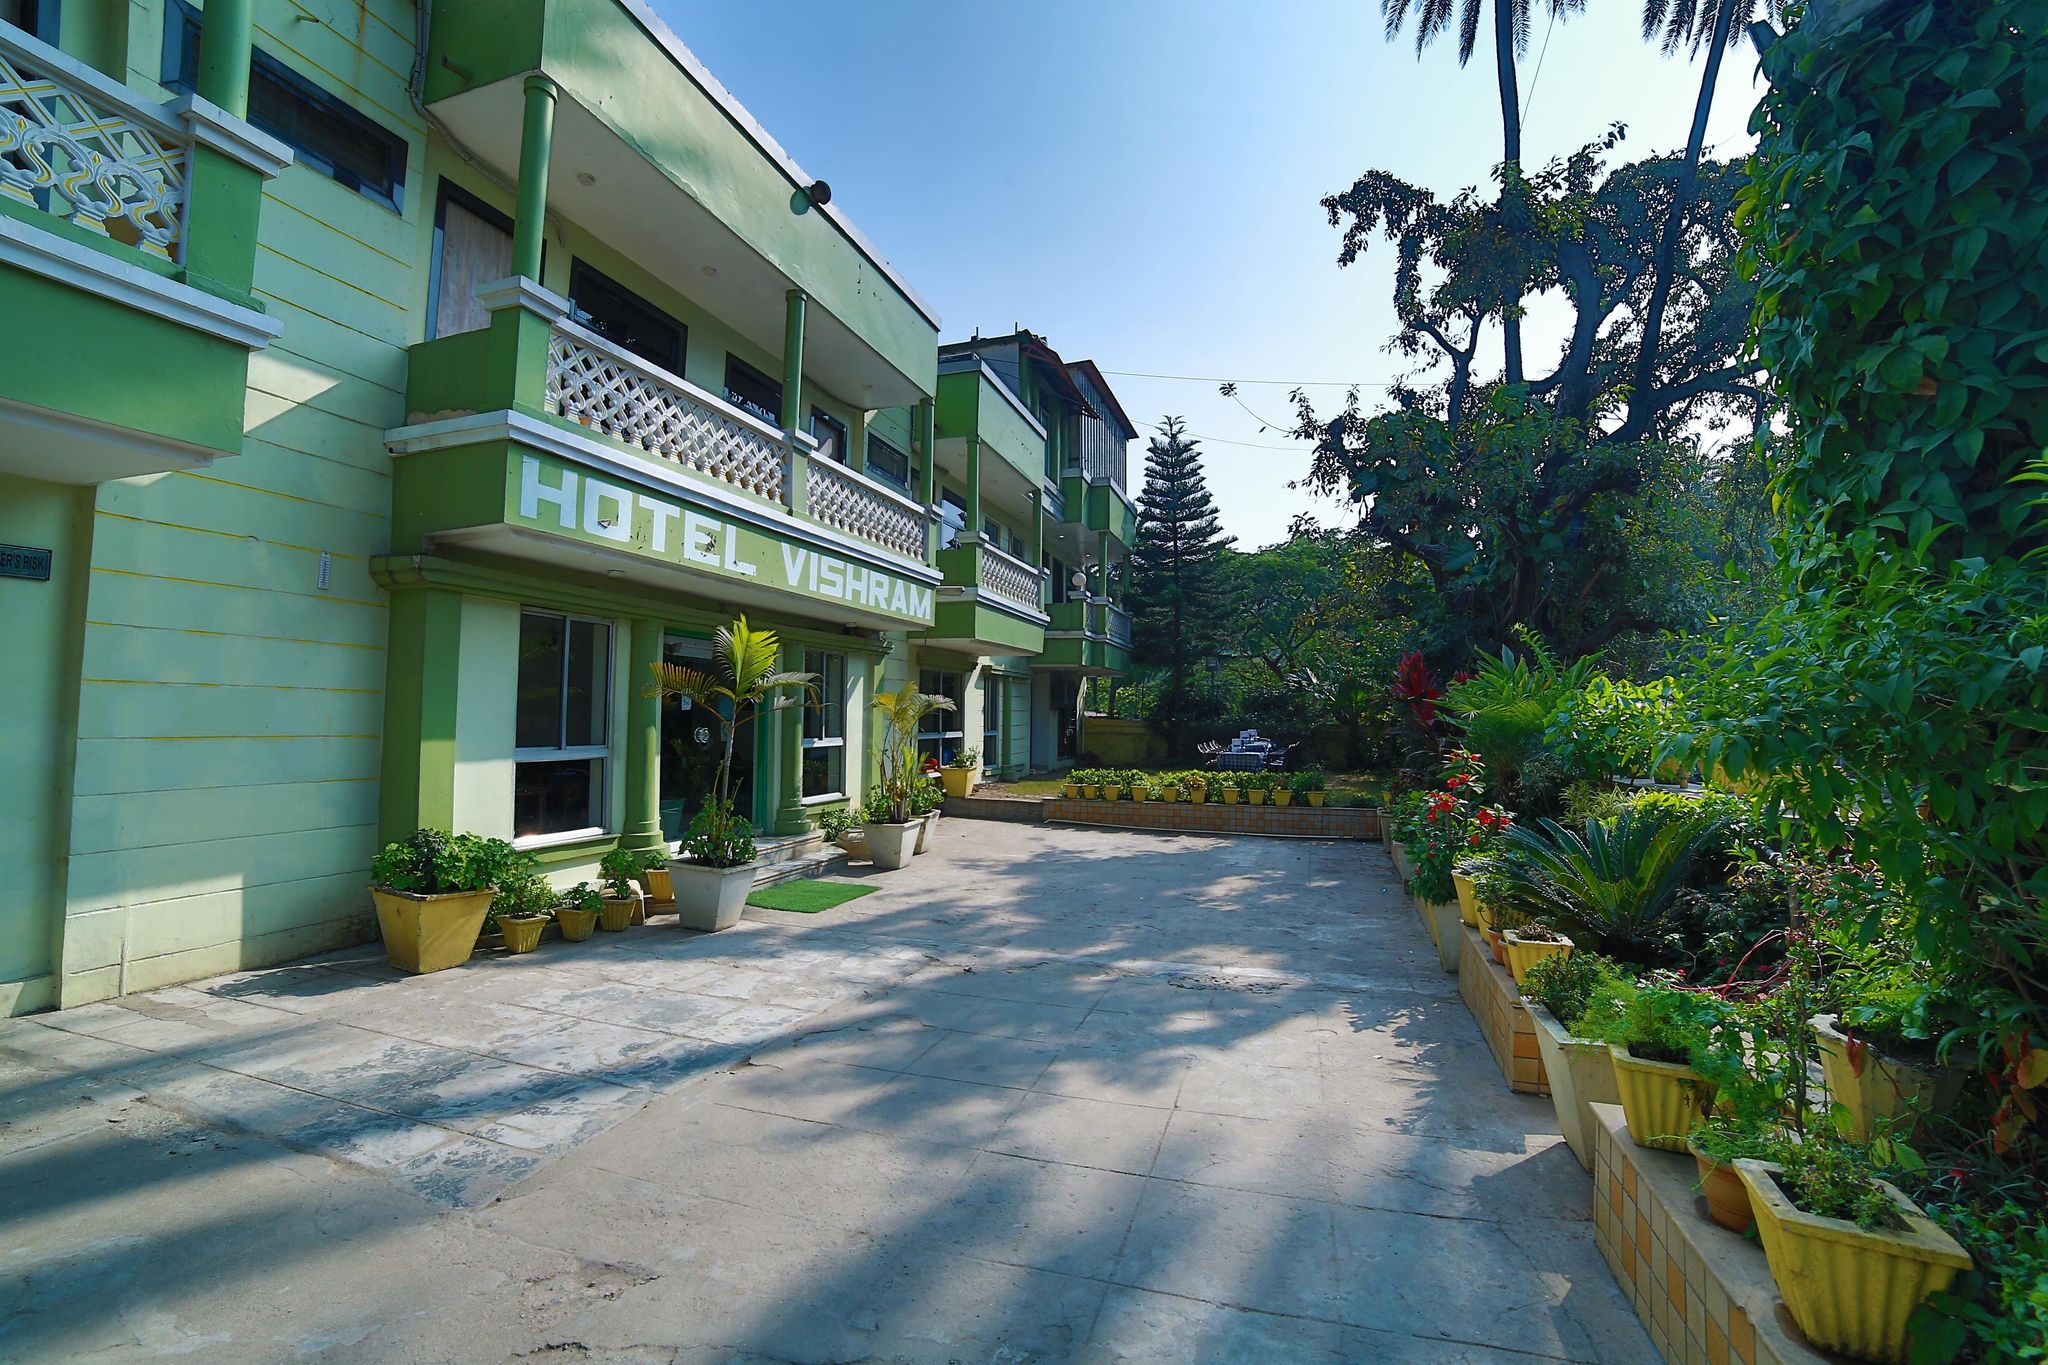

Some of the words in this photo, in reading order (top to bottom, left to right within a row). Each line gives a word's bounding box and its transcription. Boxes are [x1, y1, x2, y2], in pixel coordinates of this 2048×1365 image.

[23, 555, 44, 571] RISK
[520, 454, 757, 576] HOTEL
[780, 541, 931, 620] VISHRAM
